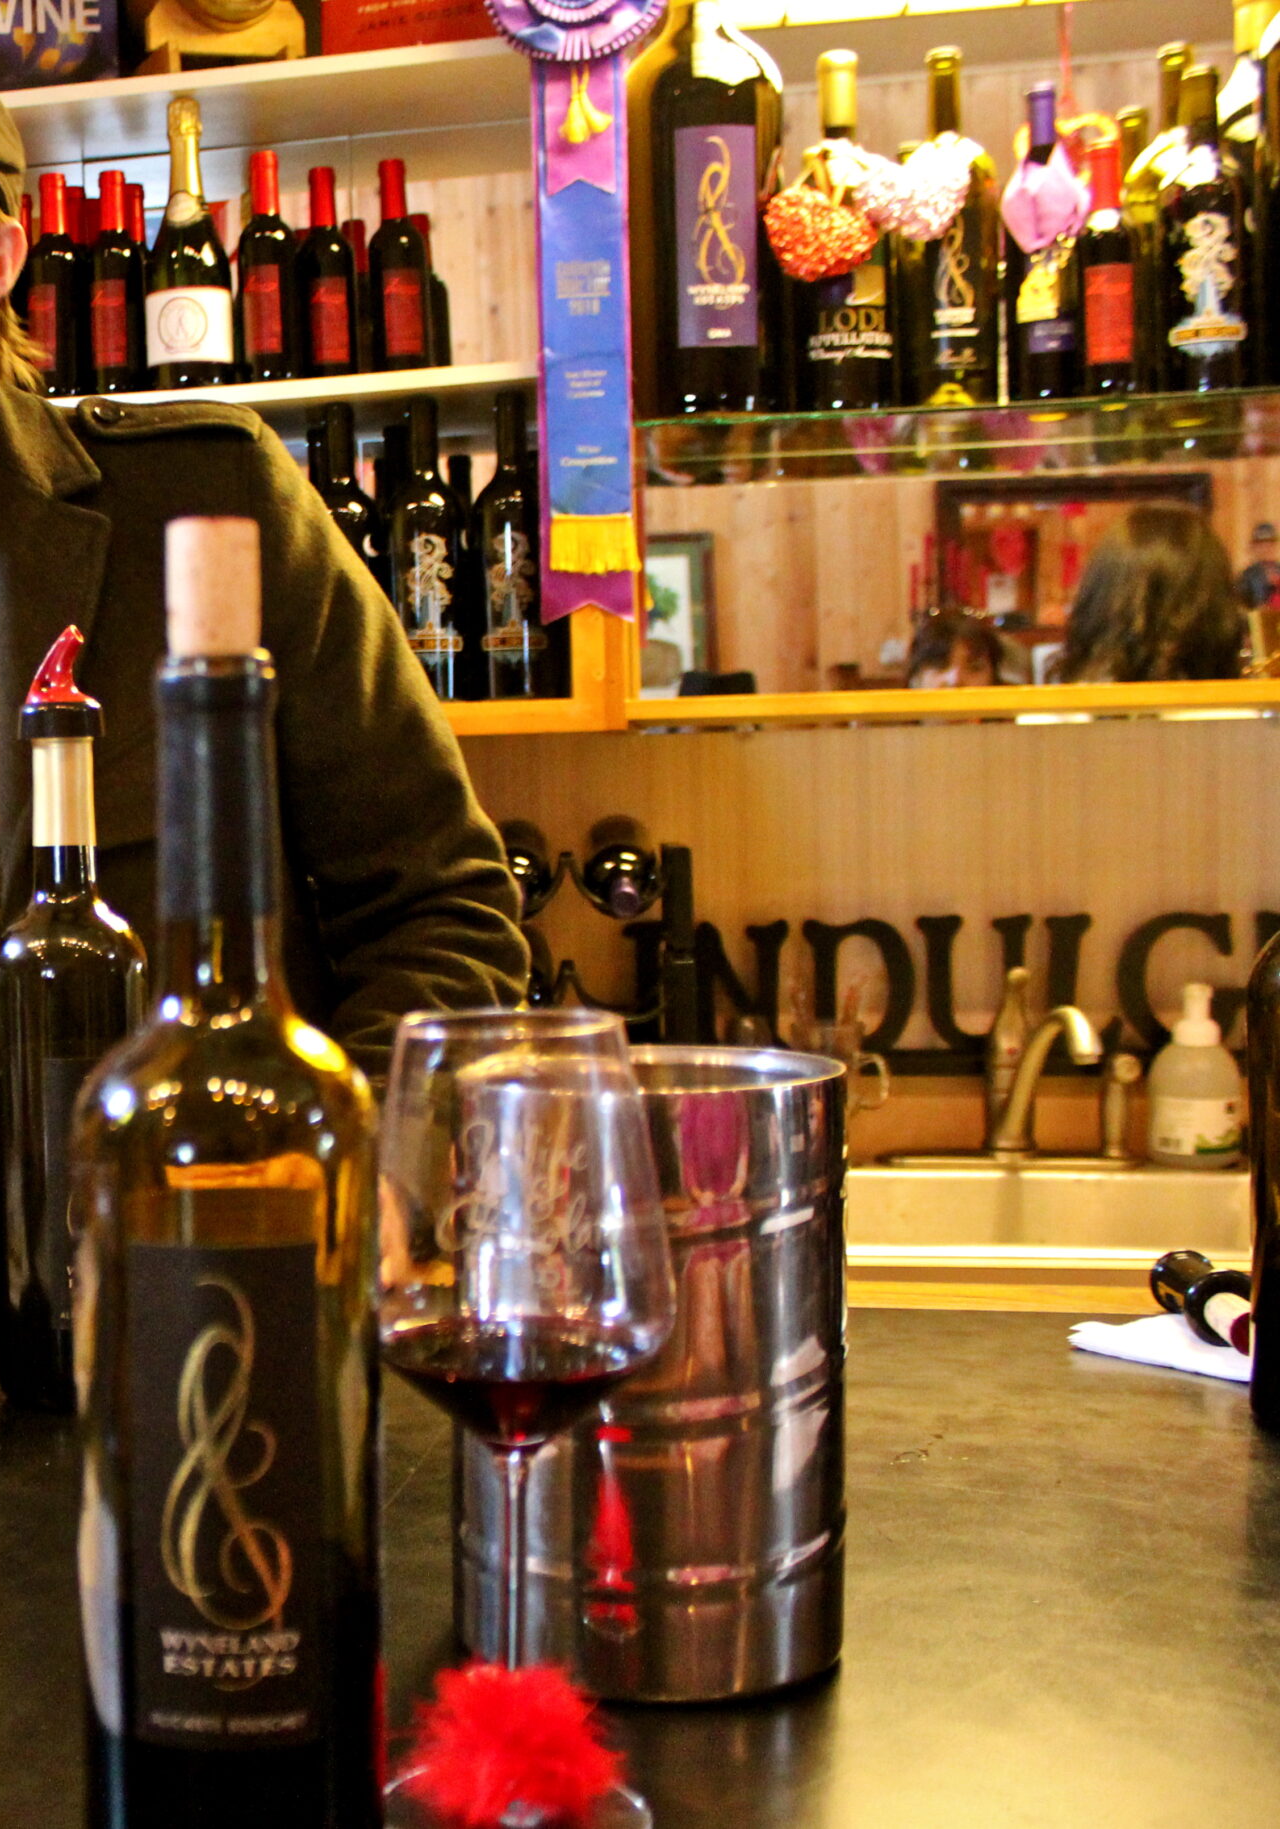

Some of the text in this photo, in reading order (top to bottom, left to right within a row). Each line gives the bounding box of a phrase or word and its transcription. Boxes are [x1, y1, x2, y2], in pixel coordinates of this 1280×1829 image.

[820, 307, 887, 333] LODI
[624, 911, 1280, 1060] INDULG
[160, 1630, 301, 1654] WYNELAND
[163, 1654, 297, 1678] ESTATES
